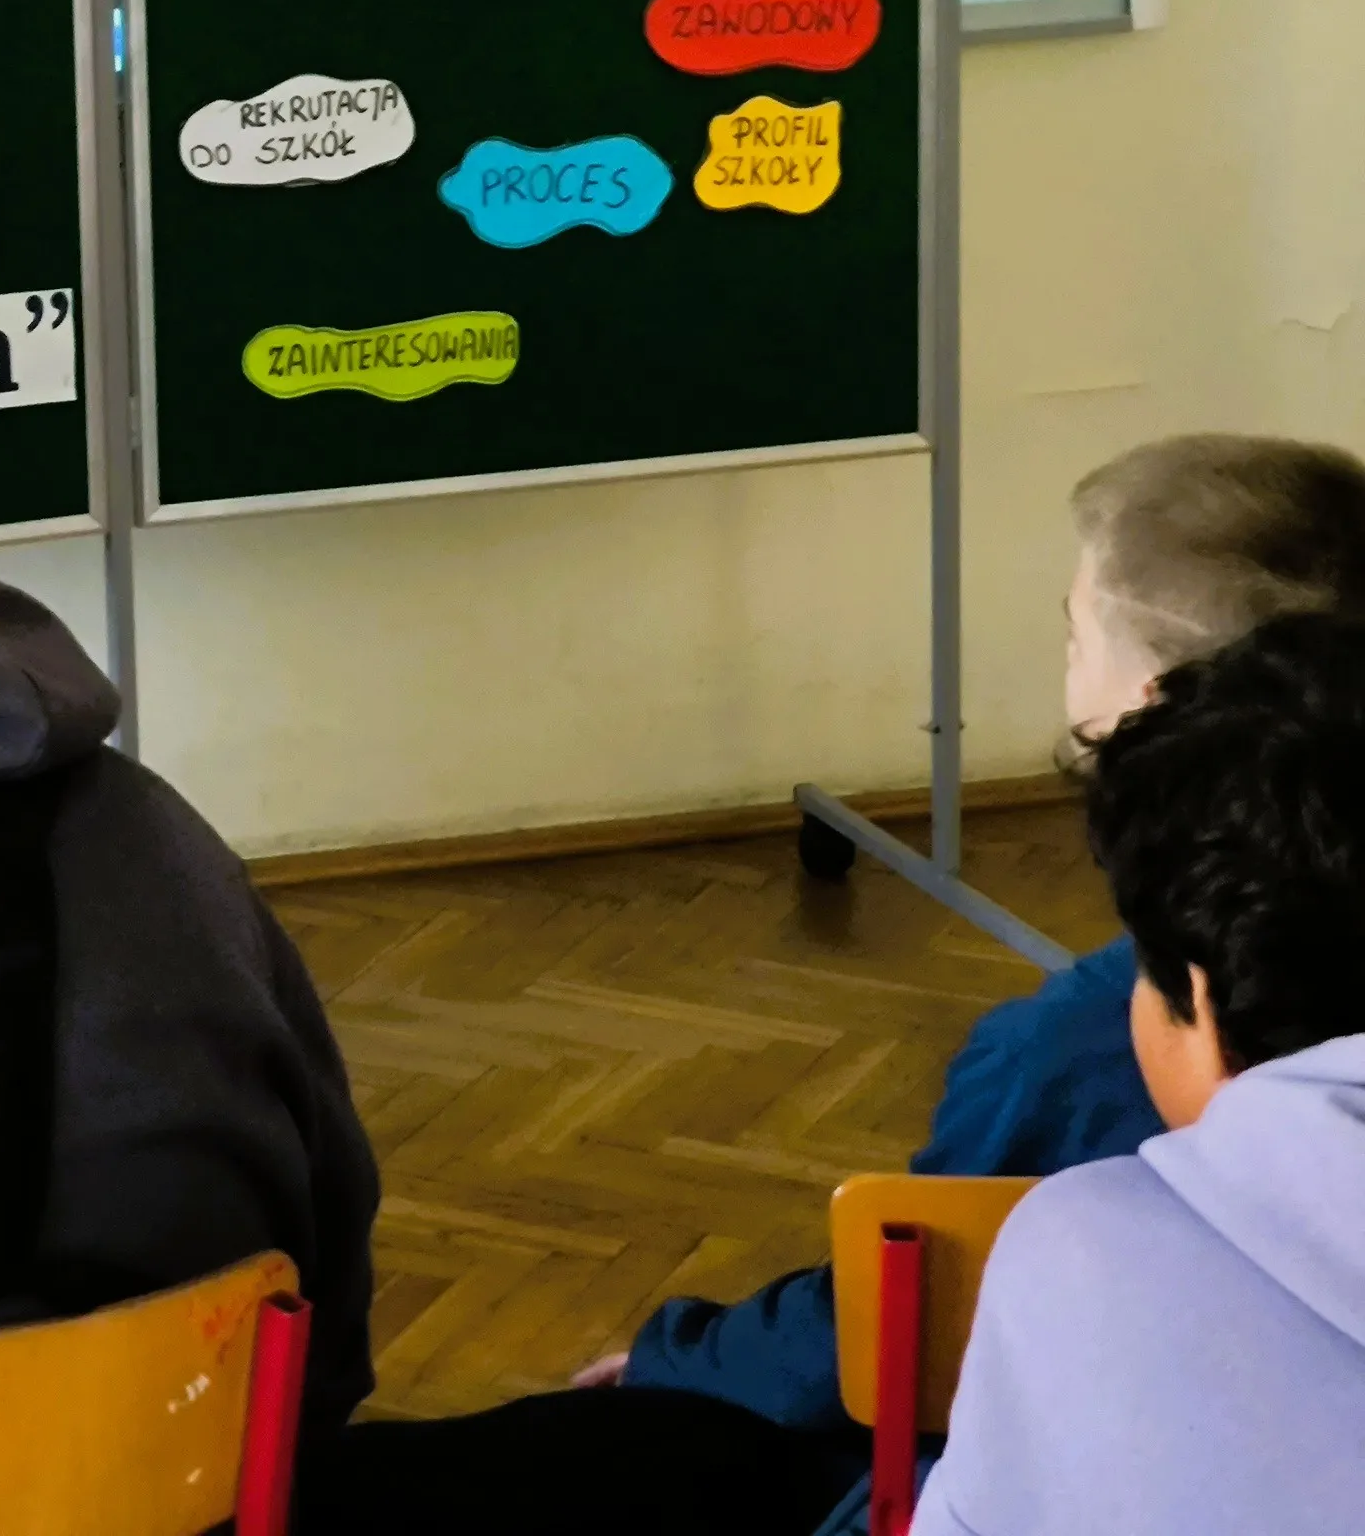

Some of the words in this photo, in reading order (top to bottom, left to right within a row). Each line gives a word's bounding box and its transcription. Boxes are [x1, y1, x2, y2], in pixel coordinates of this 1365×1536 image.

[671, 0, 862, 40] ZAWODOWY
[240, 83, 399, 130] REKRUTACJA
[190, 143, 231, 167] DO
[255, 120, 356, 164] SZKÓŁ
[733, 116, 829, 148] PROFIL
[480, 162, 632, 209] PROCES
[713, 154, 824, 188] SZKOŁY
[267, 314, 519, 378] ZAINTERESOWANIA
